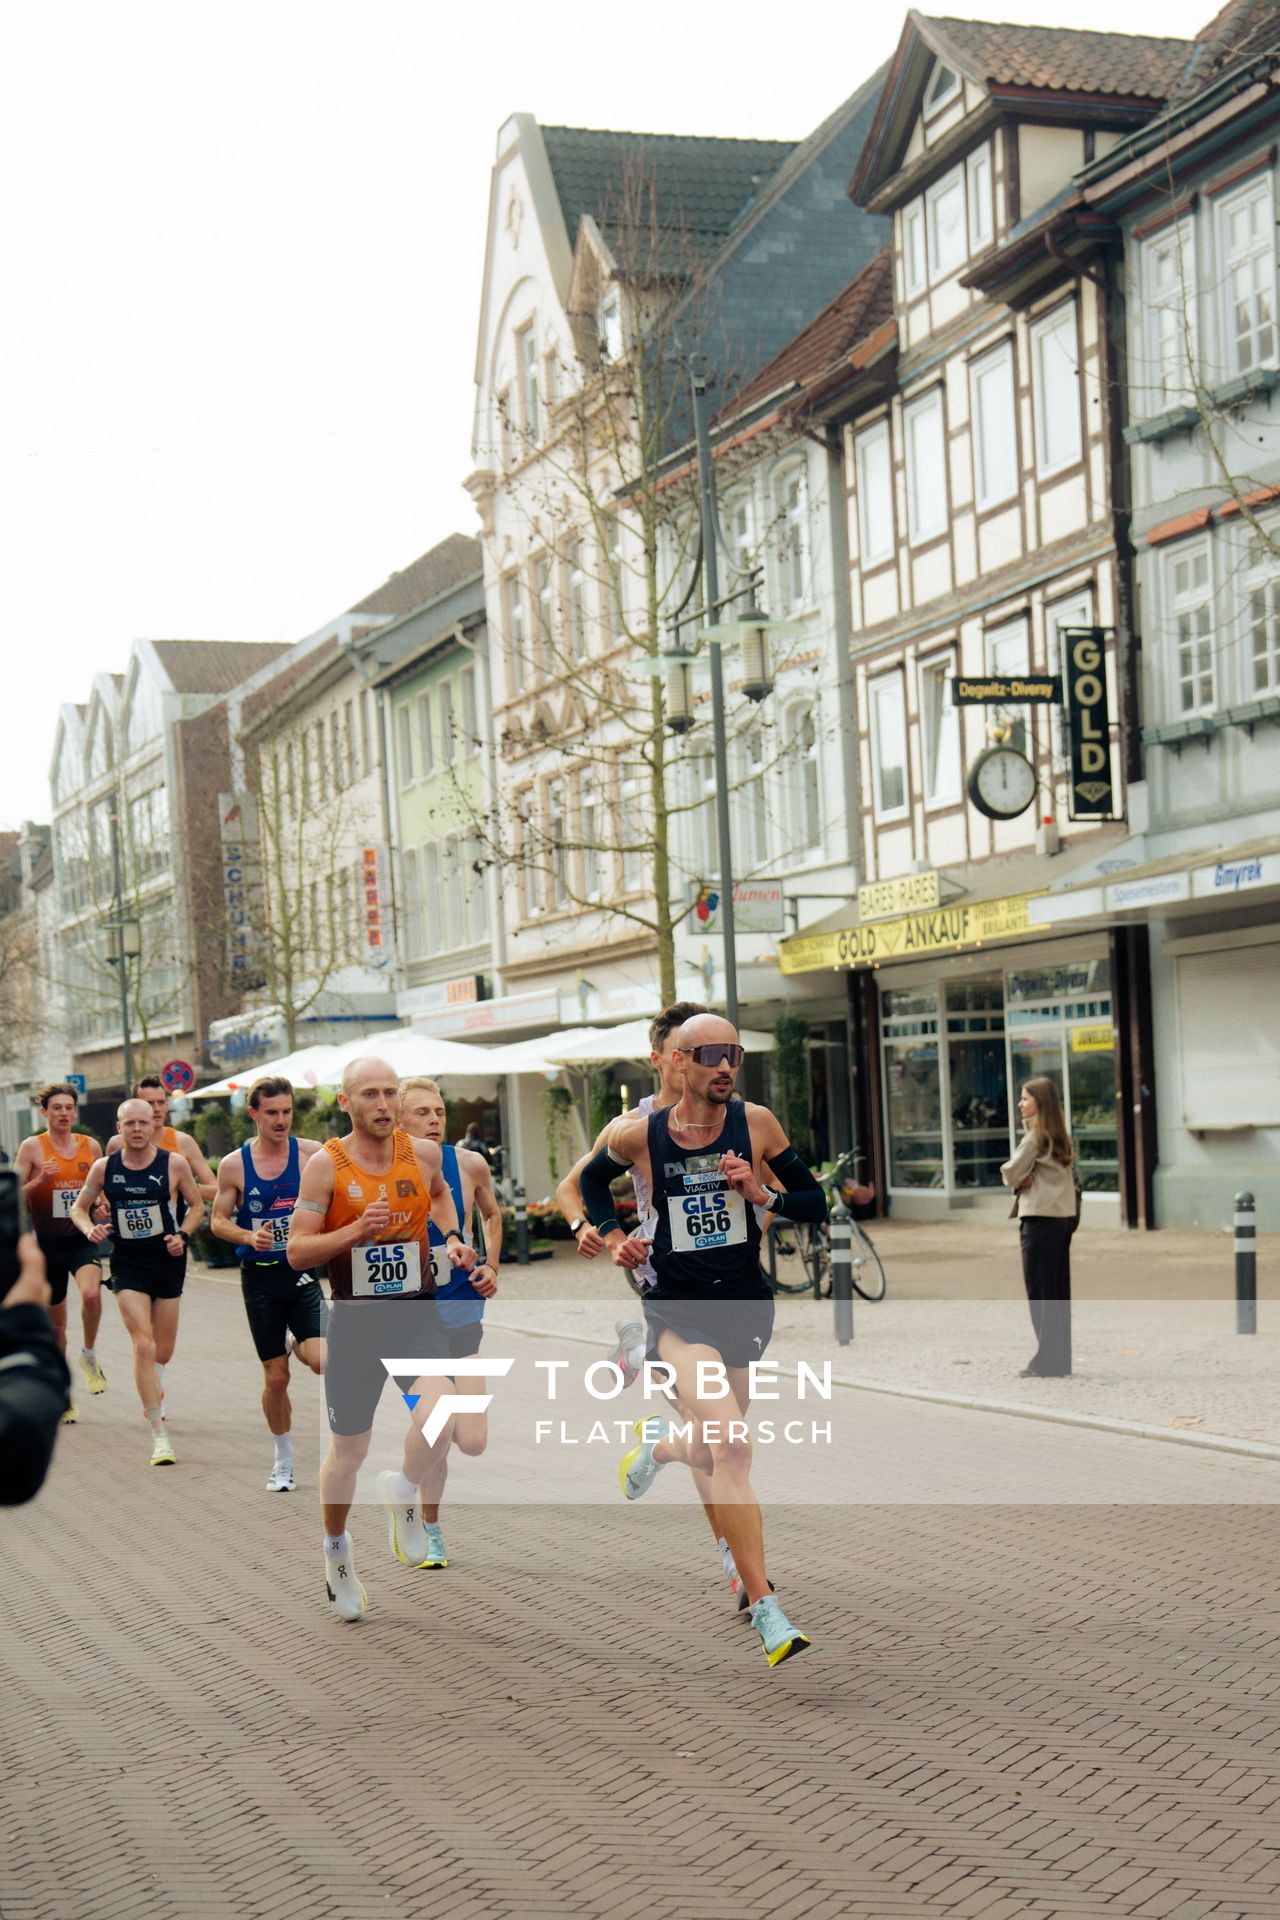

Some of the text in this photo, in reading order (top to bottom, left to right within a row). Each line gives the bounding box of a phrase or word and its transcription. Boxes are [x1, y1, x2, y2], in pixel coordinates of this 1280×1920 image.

[1073, 640, 1106, 773] GOLD
[732, 884, 780, 903] lumen
[900, 875, 936, 907] RARES
[838, 928, 876, 960] GOLD
[904, 908, 969, 950] ANKAUF
[684, 1182, 720, 1193] VIACTIV
[127, 1218, 152, 1231] 660
[686, 1210, 731, 1237] 656
[368, 1261, 408, 1283] 200
